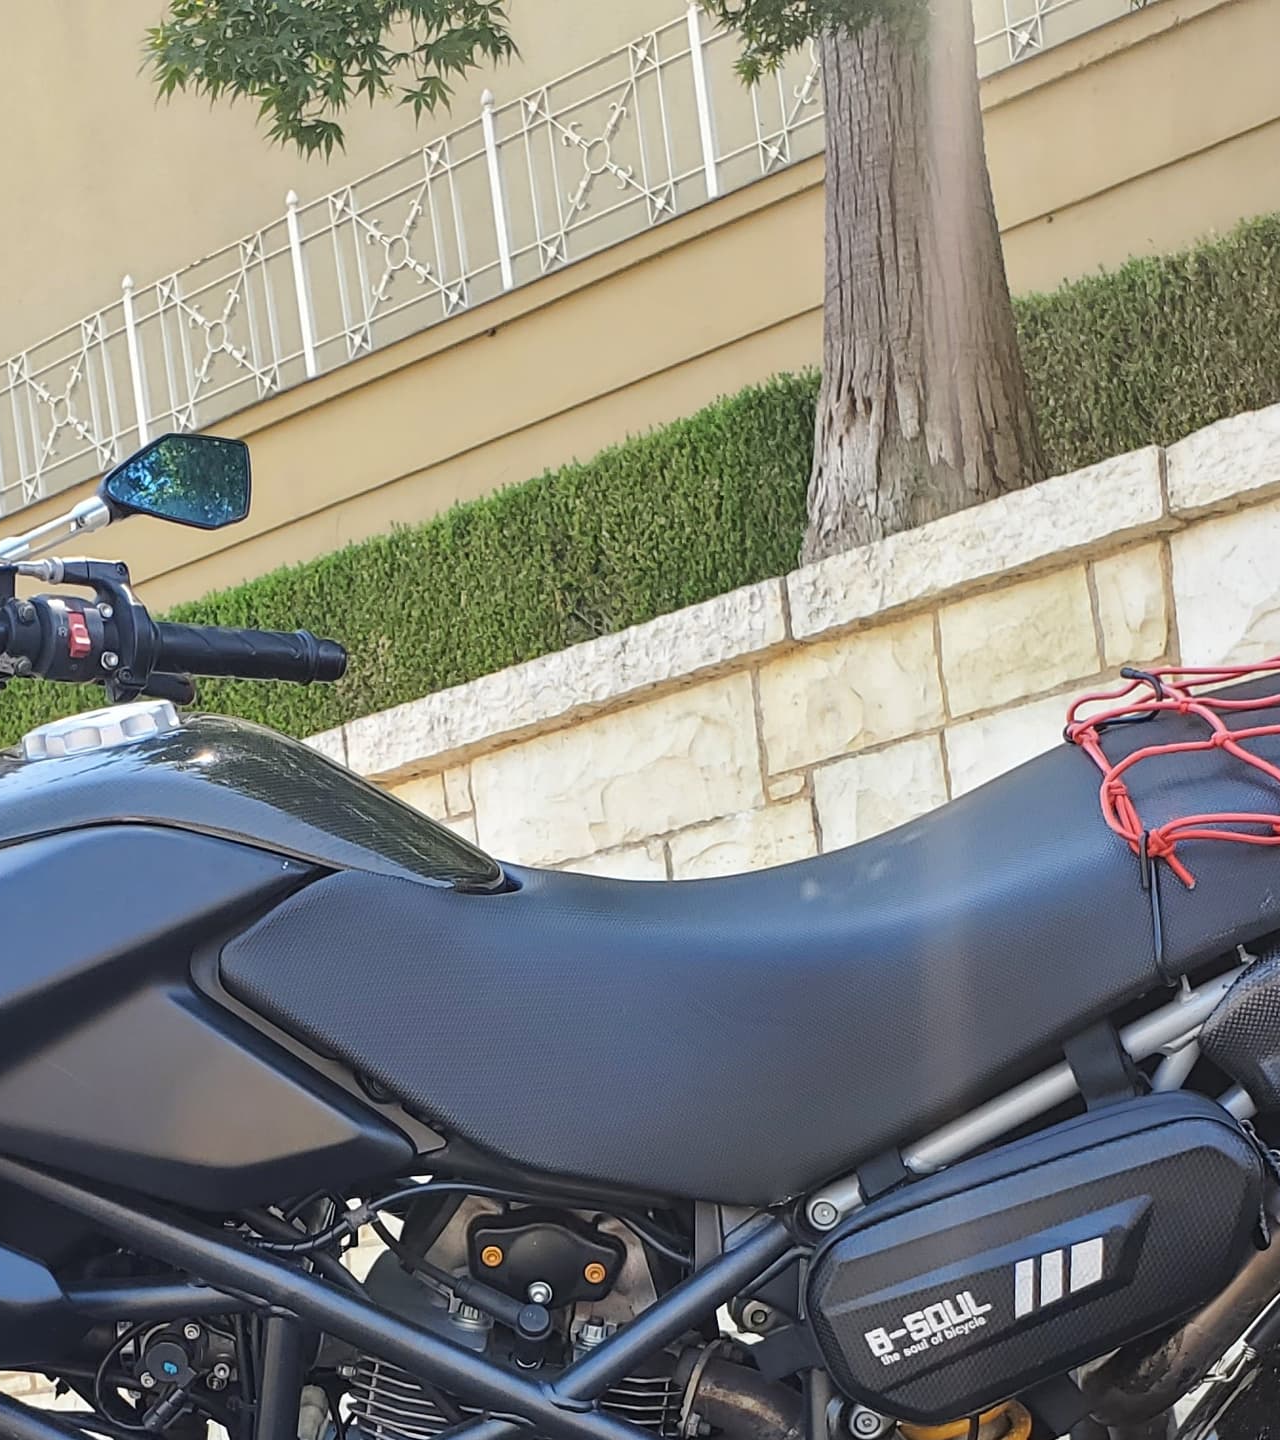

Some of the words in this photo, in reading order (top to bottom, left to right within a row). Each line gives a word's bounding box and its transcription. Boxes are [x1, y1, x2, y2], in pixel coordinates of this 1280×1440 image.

[864, 1291, 992, 1357] B-SOUL
[880, 1352, 901, 1366] the
[903, 1339, 930, 1357] soul
[930, 1332, 944, 1346] of
[943, 1315, 987, 1340] bicycle
